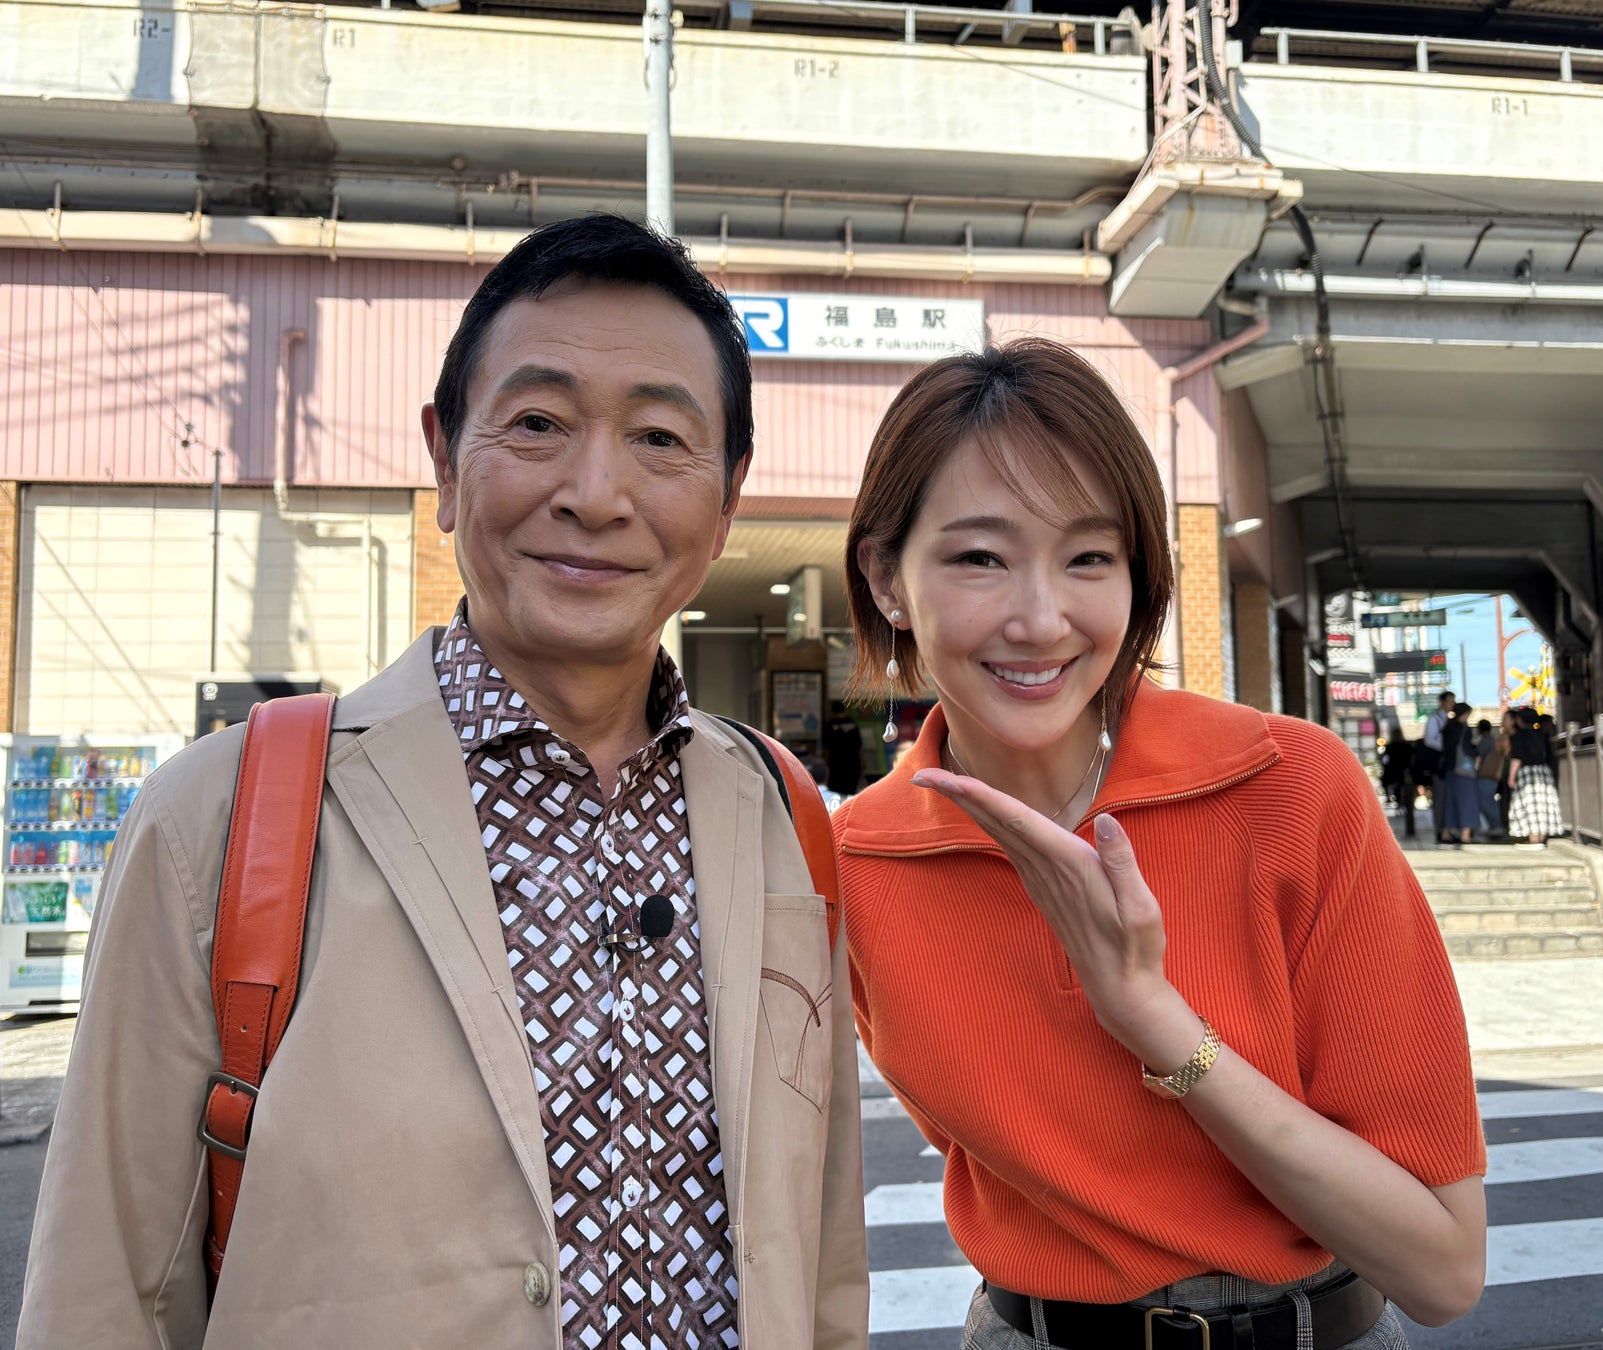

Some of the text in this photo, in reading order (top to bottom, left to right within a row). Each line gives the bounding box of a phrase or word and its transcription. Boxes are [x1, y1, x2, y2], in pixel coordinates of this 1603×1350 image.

[333, 29, 356, 48] R1
[794, 58, 839, 78] R1-2
[1492, 97, 1528, 117] R1-1
[825, 305, 946, 329] 福島駅
[816, 336, 864, 349] ふくしま
